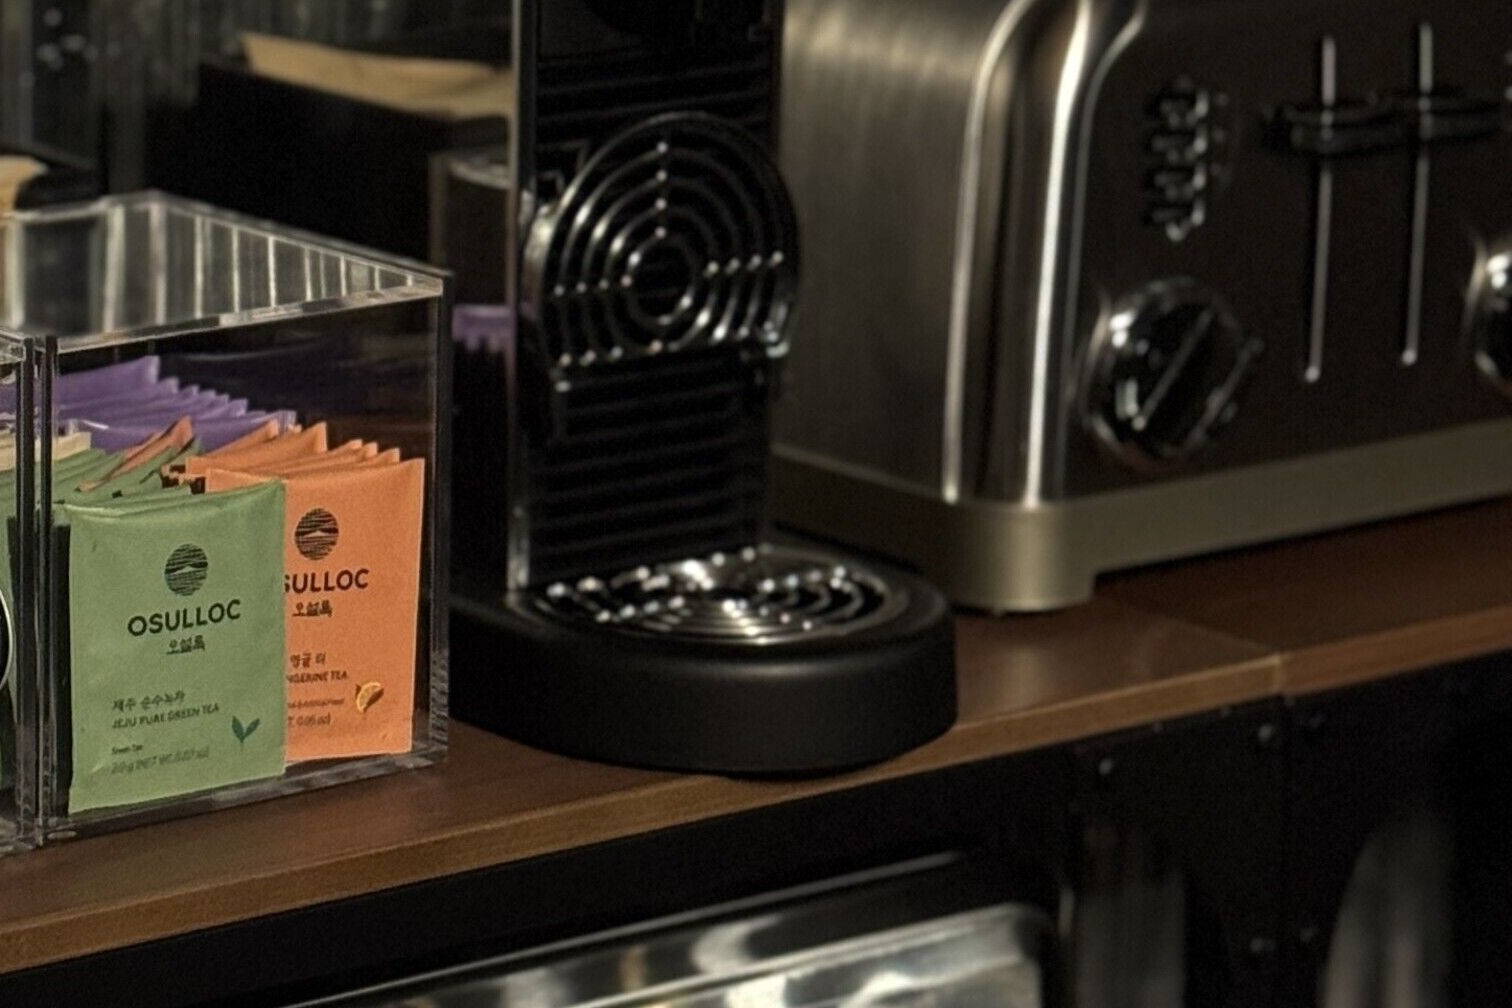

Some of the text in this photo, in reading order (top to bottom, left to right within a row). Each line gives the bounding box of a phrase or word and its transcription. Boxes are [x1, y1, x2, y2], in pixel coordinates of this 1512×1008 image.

[127, 598, 241, 637] OSULLOC
[330, 670, 348, 681] TEA
[112, 717, 138, 729] JEJU
[167, 707, 200, 722] GREEN
[202, 703, 220, 714] TEA
